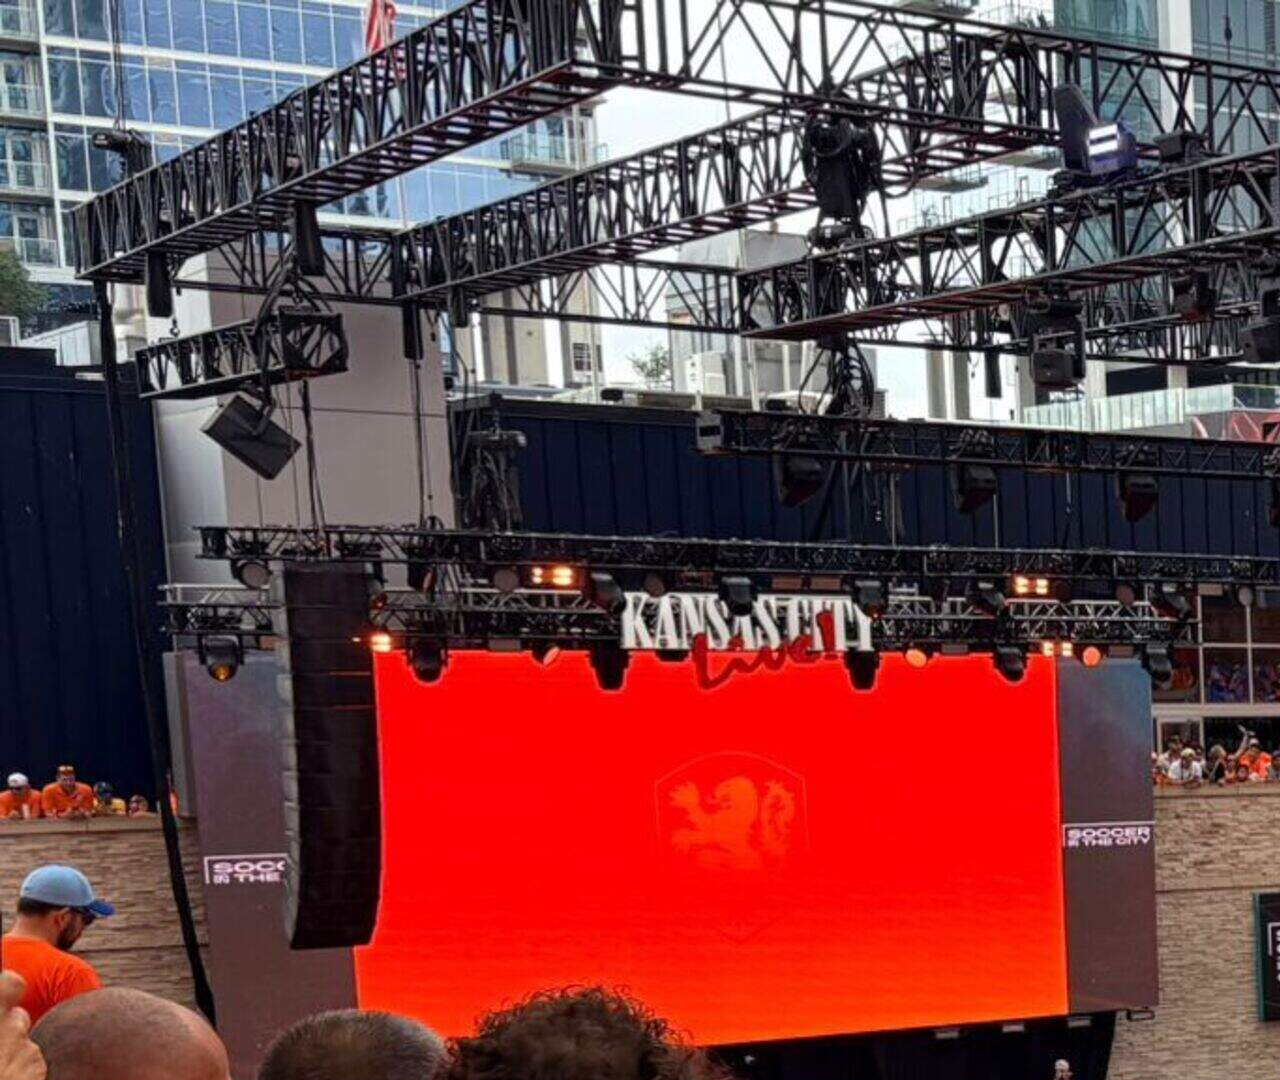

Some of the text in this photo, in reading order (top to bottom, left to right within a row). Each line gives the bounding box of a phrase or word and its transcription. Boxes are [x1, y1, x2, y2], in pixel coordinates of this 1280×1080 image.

[620, 592, 782, 650] KANSAS
[1068, 826, 1151, 838] SOCCER
[213, 860, 285, 873] SOC
